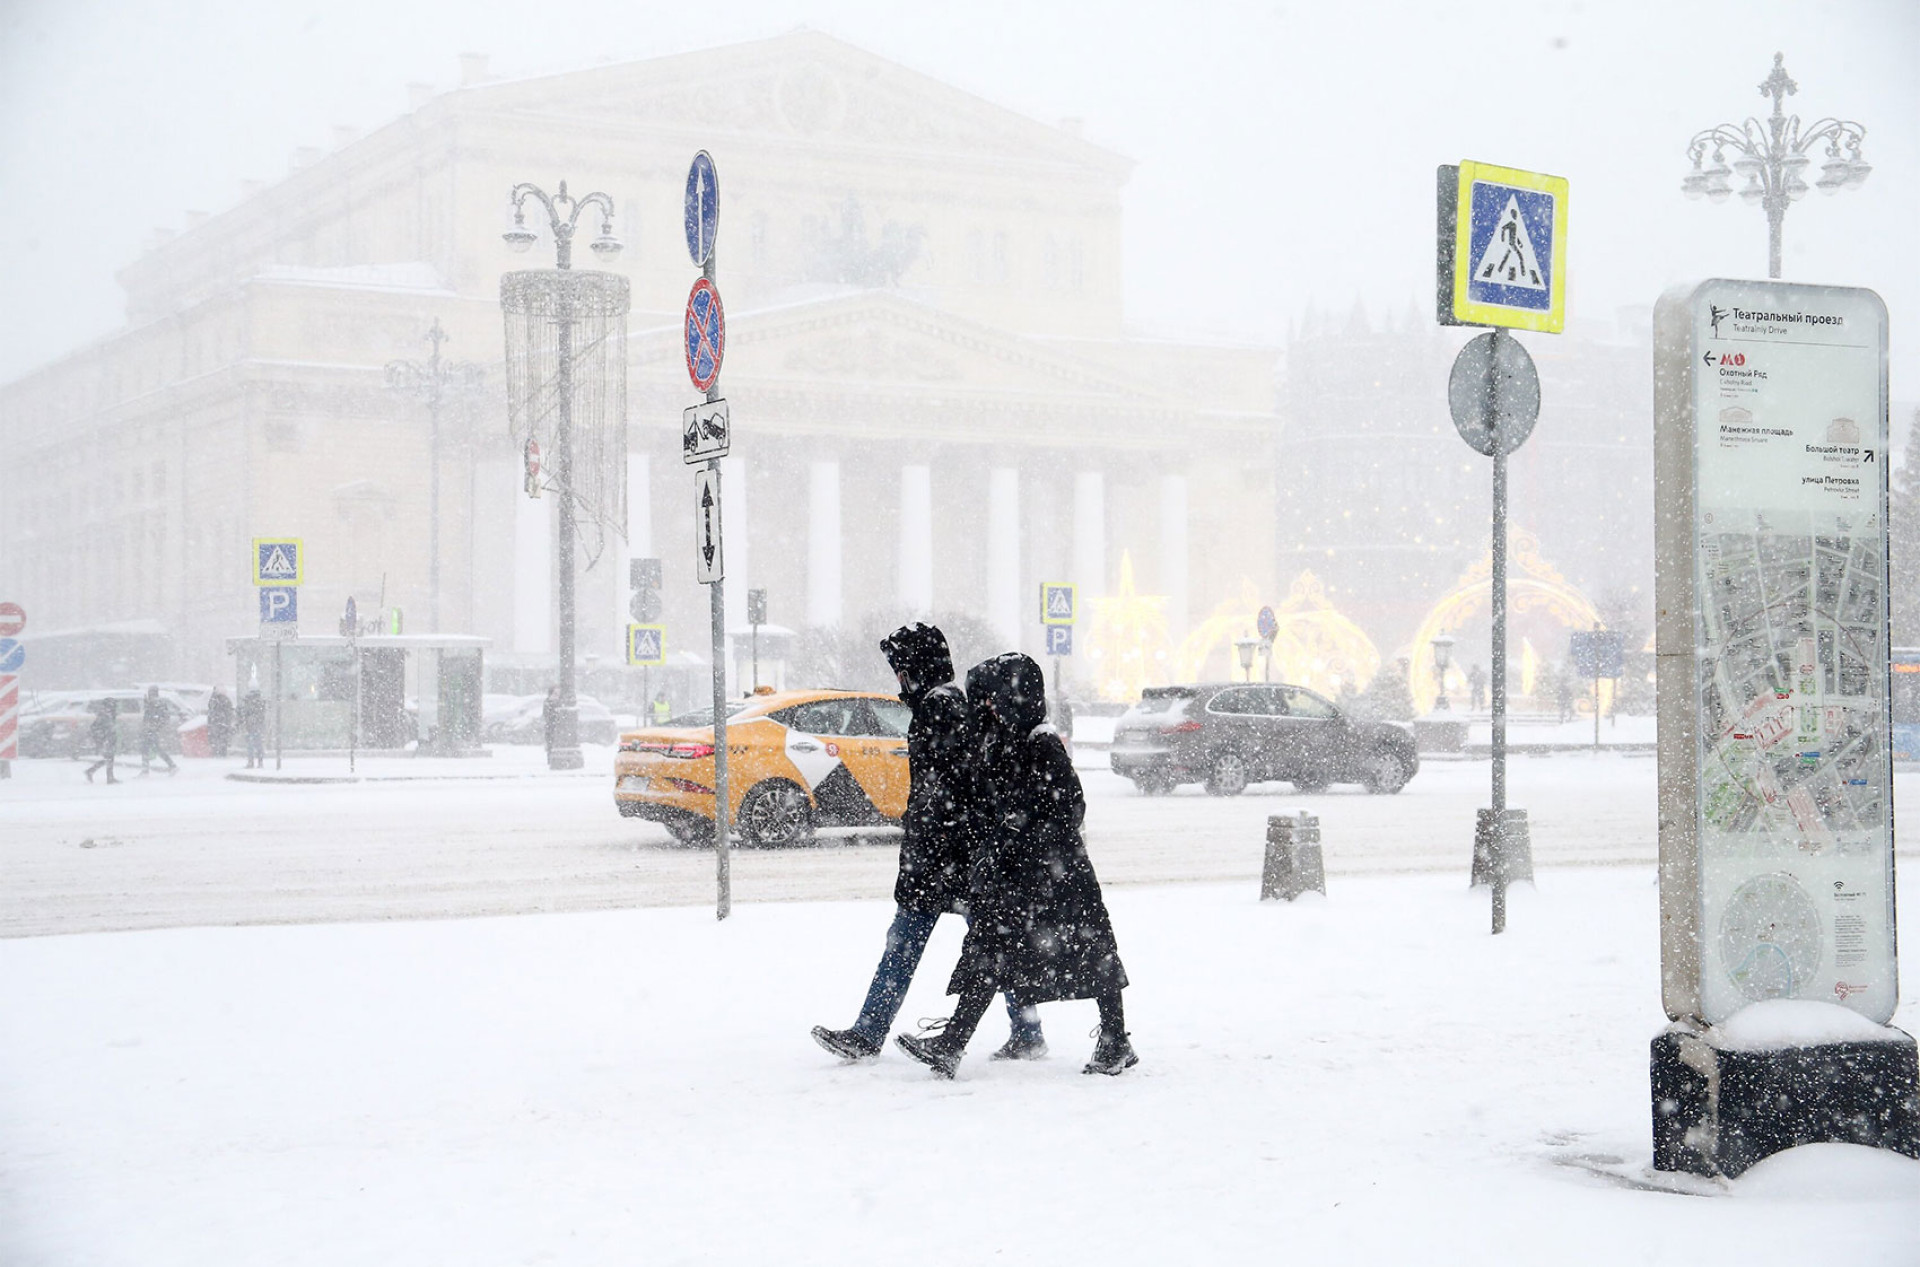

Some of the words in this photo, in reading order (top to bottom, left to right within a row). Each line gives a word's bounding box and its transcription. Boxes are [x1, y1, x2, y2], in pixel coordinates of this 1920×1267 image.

[1733, 308, 1802, 323] Театральный
[1805, 314, 1844, 326] проезд
[1768, 325, 1788, 335] Drive
[1719, 367, 1752, 378] Охотный
[1753, 369, 1768, 379] Ряд
[1720, 425, 1760, 434] Манежная
[1761, 428, 1794, 437] площадь
[1805, 444, 1838, 453] Большой
[1839, 447, 1860, 456] театр
[1801, 476, 1823, 485] улица
[1824, 475, 1859, 485] Петровка
[269, 591, 290, 619] P
[1053, 628, 1067, 651] P
